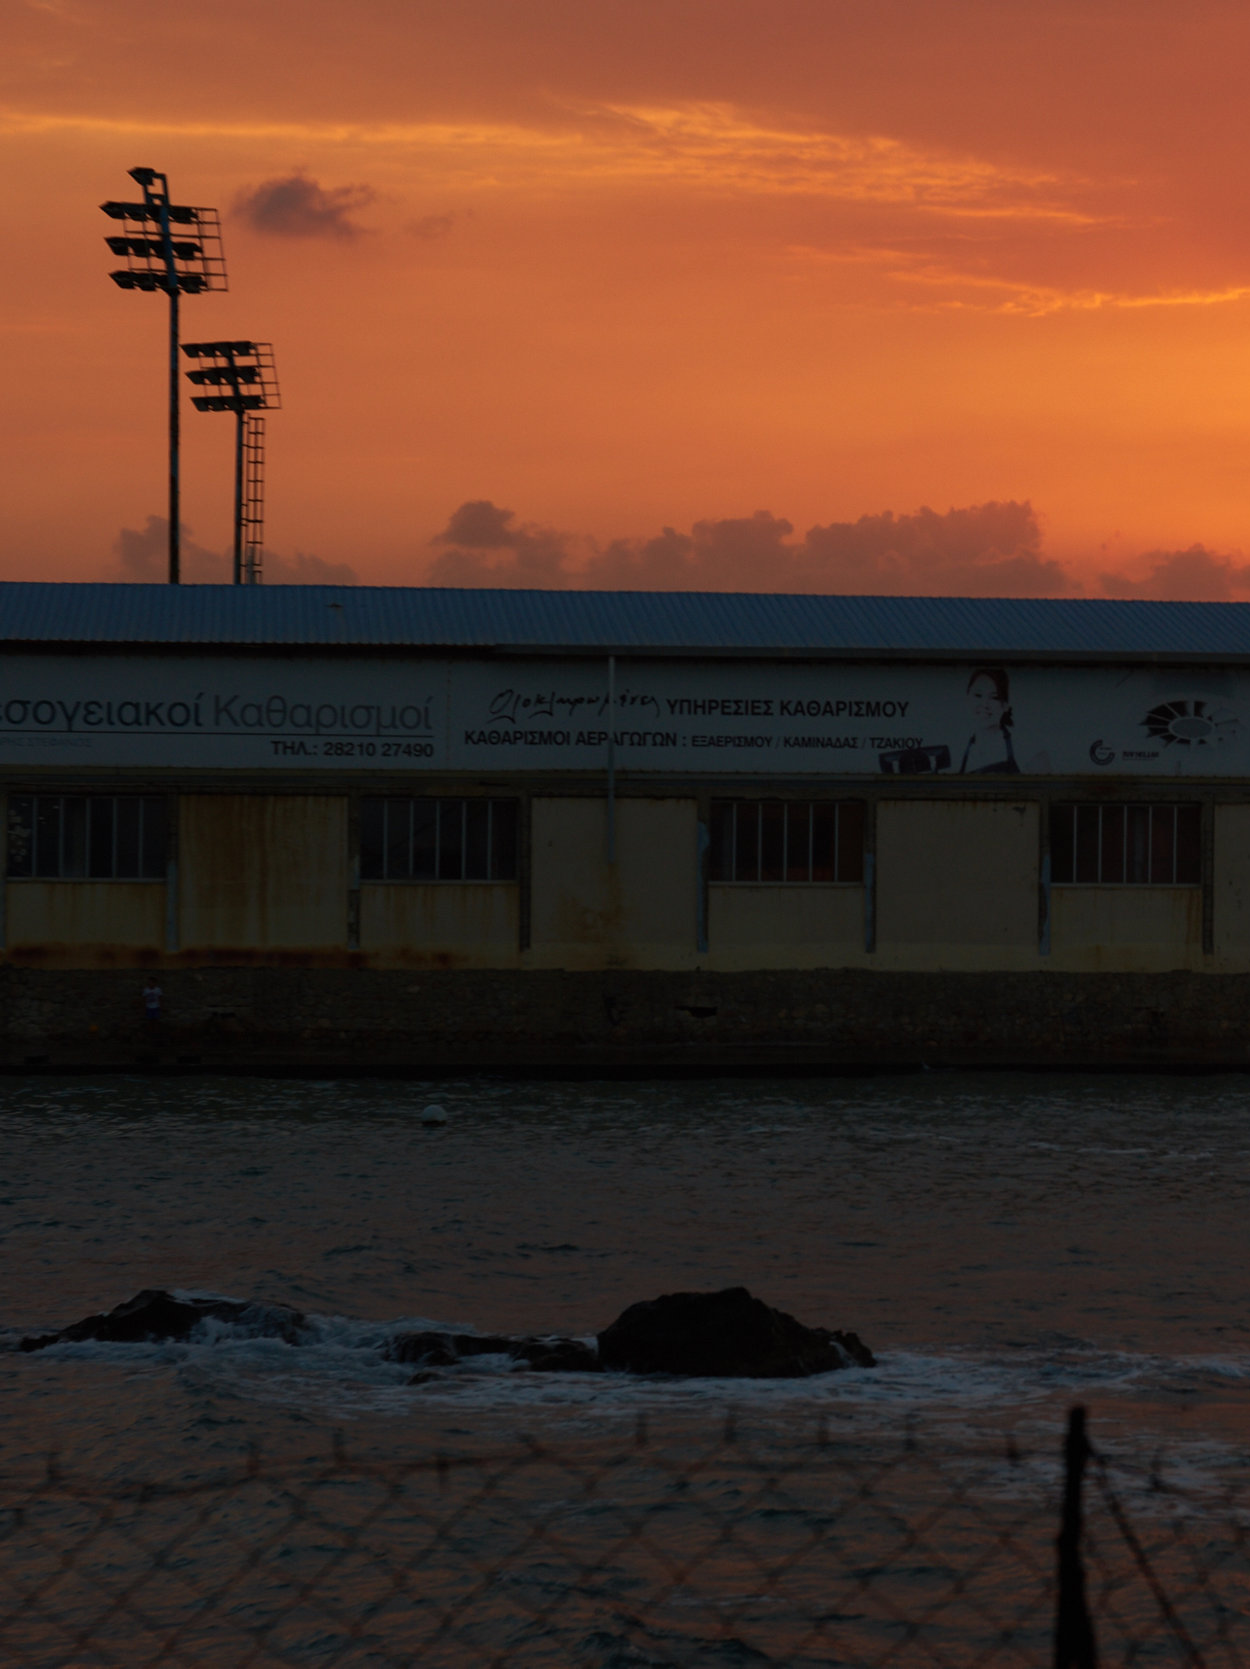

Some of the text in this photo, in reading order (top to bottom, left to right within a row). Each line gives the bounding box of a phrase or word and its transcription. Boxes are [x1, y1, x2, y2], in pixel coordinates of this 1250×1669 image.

[0, 692, 434, 736] σογειακοί Καθαρισμοί
[667, 698, 774, 717] ΥΠΗΡΕΣΙΕΣ
[779, 699, 910, 718] ΚΑΘΑΡΙΣΜΟΥ
[270, 740, 435, 758] ΤΗΛ.: 28210 27490
[464, 730, 571, 746] ΚΑΘΑΡΙΣΜΟΙ
[691, 735, 774, 748] ΕΞΑΕΡΙΣΜΟΥ
[783, 736, 859, 749] ΚΑΜΙΝΑΔΑΣ
[869, 737, 925, 750] ΤΖΑΚΙΟΥ
